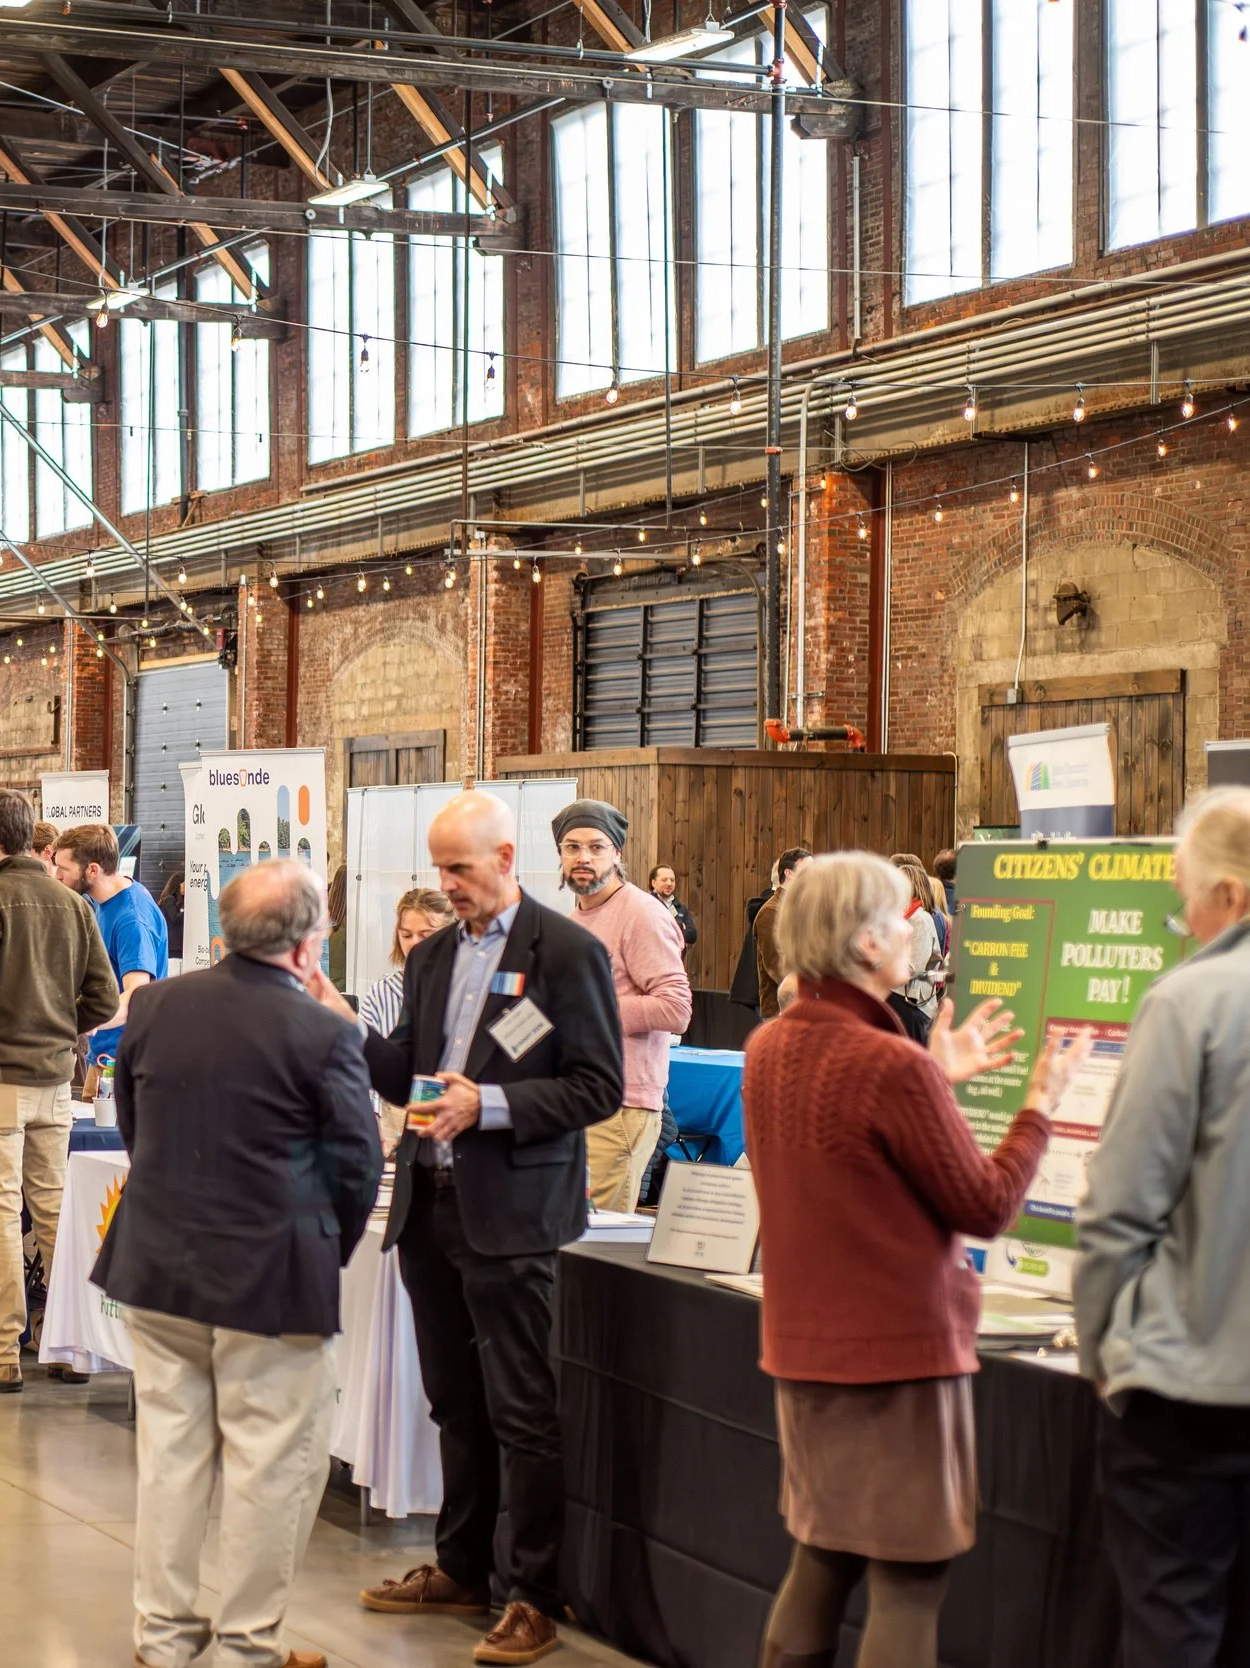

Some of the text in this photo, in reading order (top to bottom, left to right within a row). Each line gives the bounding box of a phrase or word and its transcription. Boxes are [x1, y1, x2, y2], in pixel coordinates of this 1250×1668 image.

[46, 805, 102, 818] GLOBAL PARTNERS
[994, 851, 1086, 880] CITIZENS'
[971, 904, 1035, 923] Founding Goal:
[1088, 909, 1143, 935] MAKE
[1061, 941, 1164, 971] POLLUTERS
[990, 960, 999, 976] &
